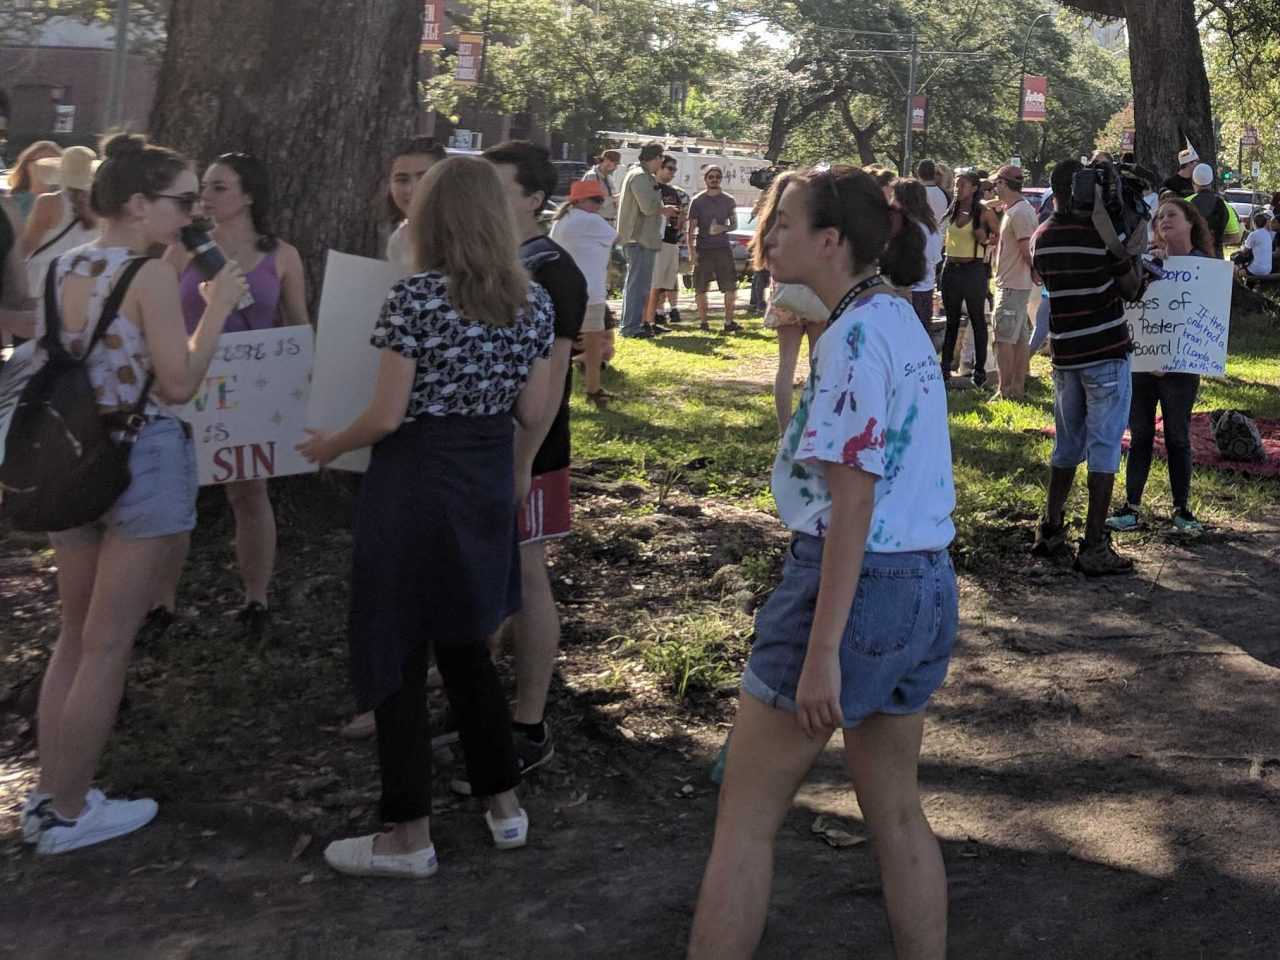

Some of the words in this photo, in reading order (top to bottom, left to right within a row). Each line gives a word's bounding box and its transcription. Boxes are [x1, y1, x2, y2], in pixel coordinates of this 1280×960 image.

[1168, 291, 1192, 312] of
[1140, 319, 1185, 337] Poster
[212, 441, 276, 482] SIN
